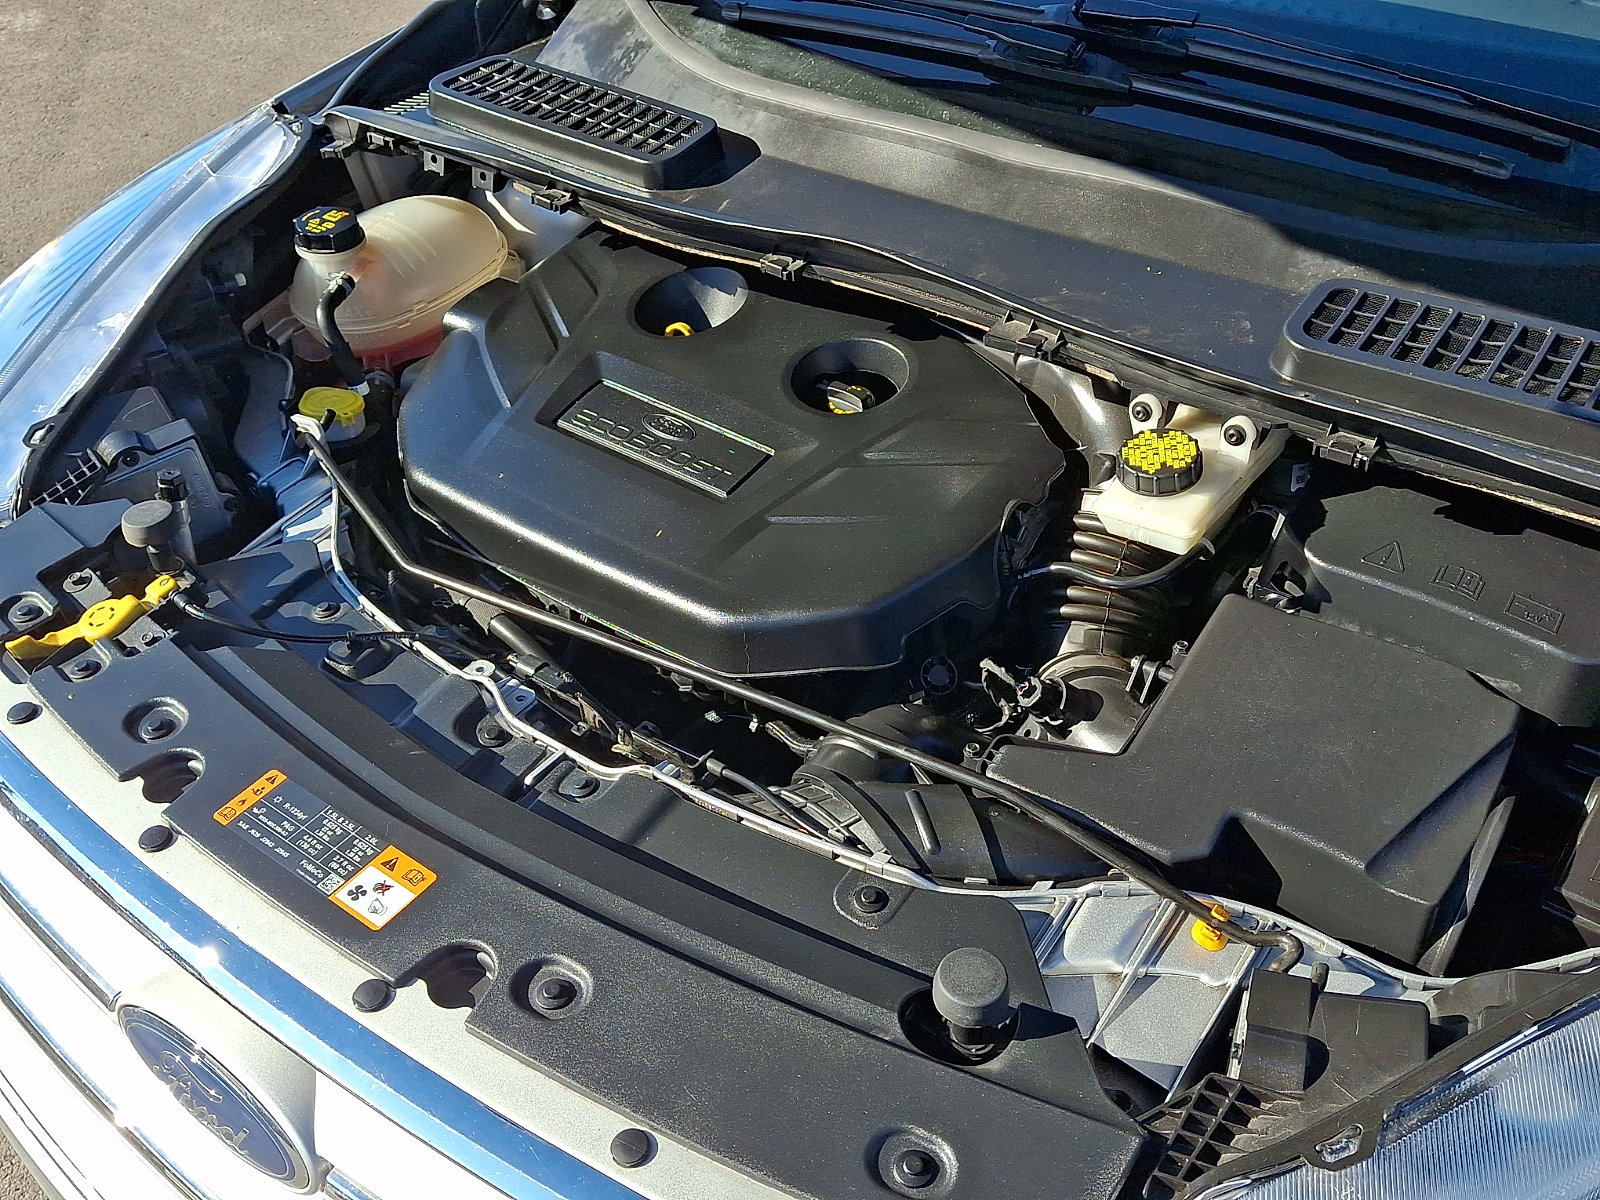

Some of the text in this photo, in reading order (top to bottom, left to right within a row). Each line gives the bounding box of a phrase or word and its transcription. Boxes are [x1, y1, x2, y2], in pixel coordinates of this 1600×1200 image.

[571, 409, 733, 480] ECOBOOST
[280, 820, 295, 831] PAG
[299, 859, 324, 878] FoMoCo
[151, 1050, 250, 1156] Ford
